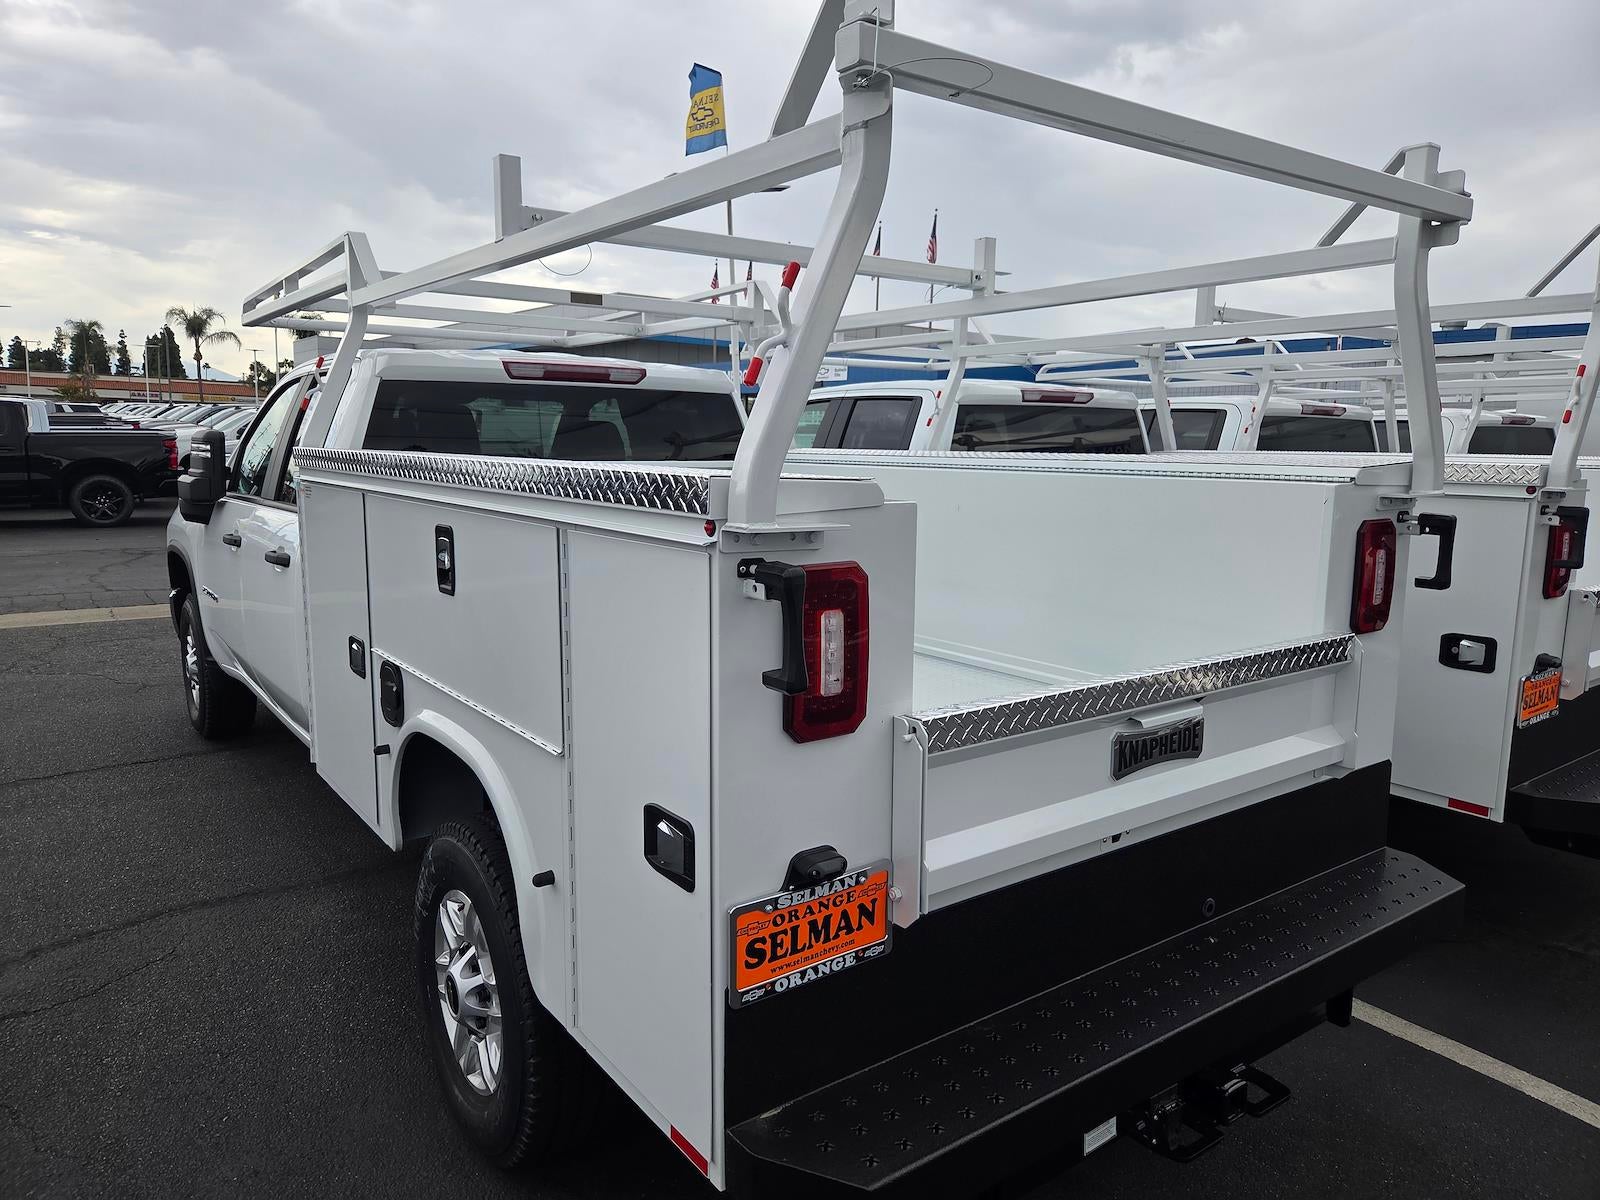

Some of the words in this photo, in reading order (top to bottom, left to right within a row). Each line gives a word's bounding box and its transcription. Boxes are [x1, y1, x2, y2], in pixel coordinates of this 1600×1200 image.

[1522, 684, 1558, 711] SELMAN
[1118, 719, 1200, 772] KNAPHEIDE
[771, 889, 857, 928] ORANGE
[776, 873, 859, 909] SELMAN
[744, 897, 879, 970] SELMAN
[770, 938, 856, 975] www.selmanchevy.com
[774, 952, 857, 993] ORANGE
